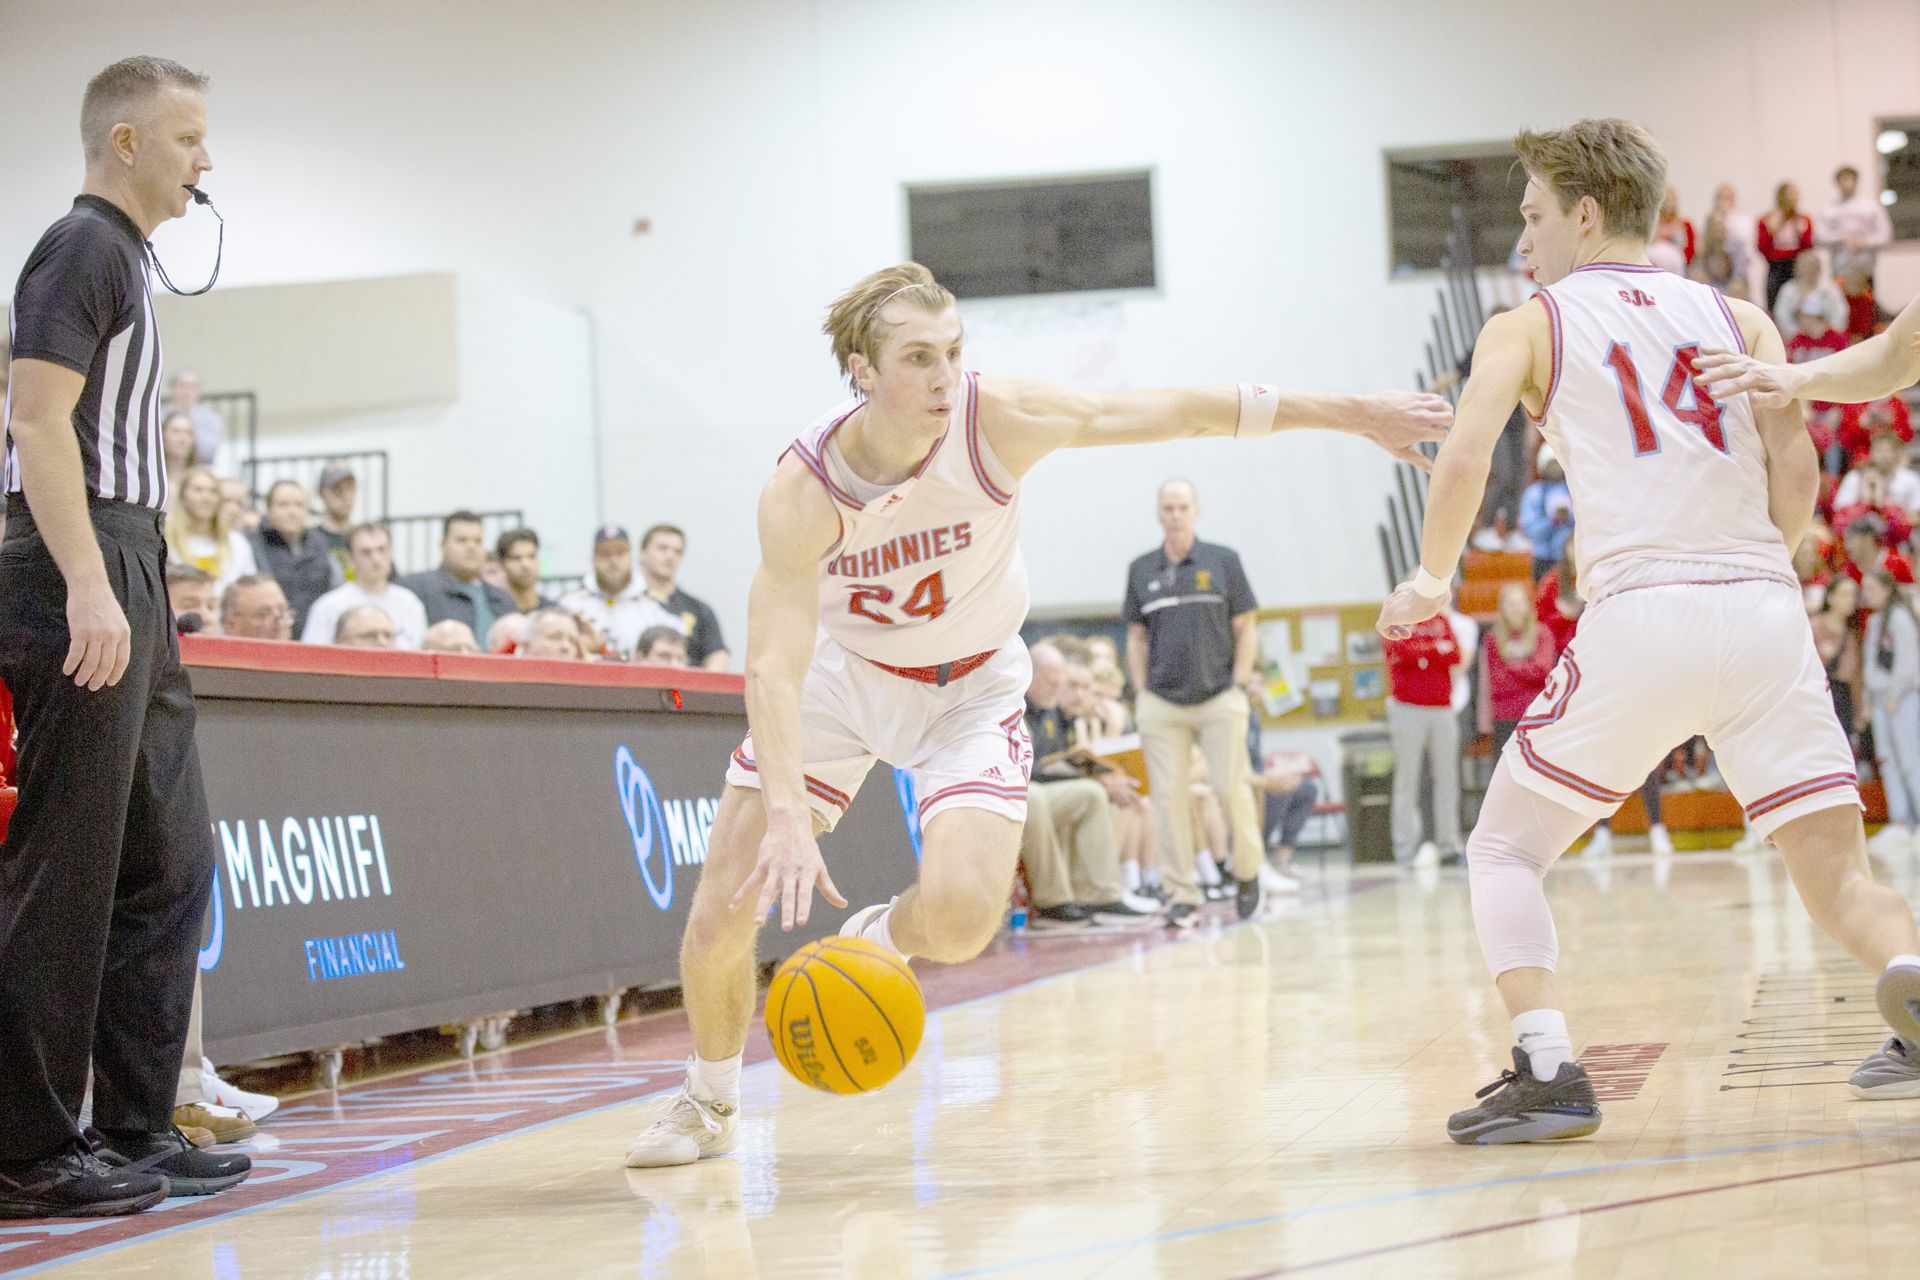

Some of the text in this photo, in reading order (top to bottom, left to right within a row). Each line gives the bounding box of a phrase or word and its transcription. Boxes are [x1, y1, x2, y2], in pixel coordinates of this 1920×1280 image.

[1603, 339, 1730, 457] 14
[844, 569, 953, 625] 24
[219, 815, 391, 908] MAGNIFI
[663, 797, 720, 865] MAG
[304, 928, 404, 982] FINANCIAL
